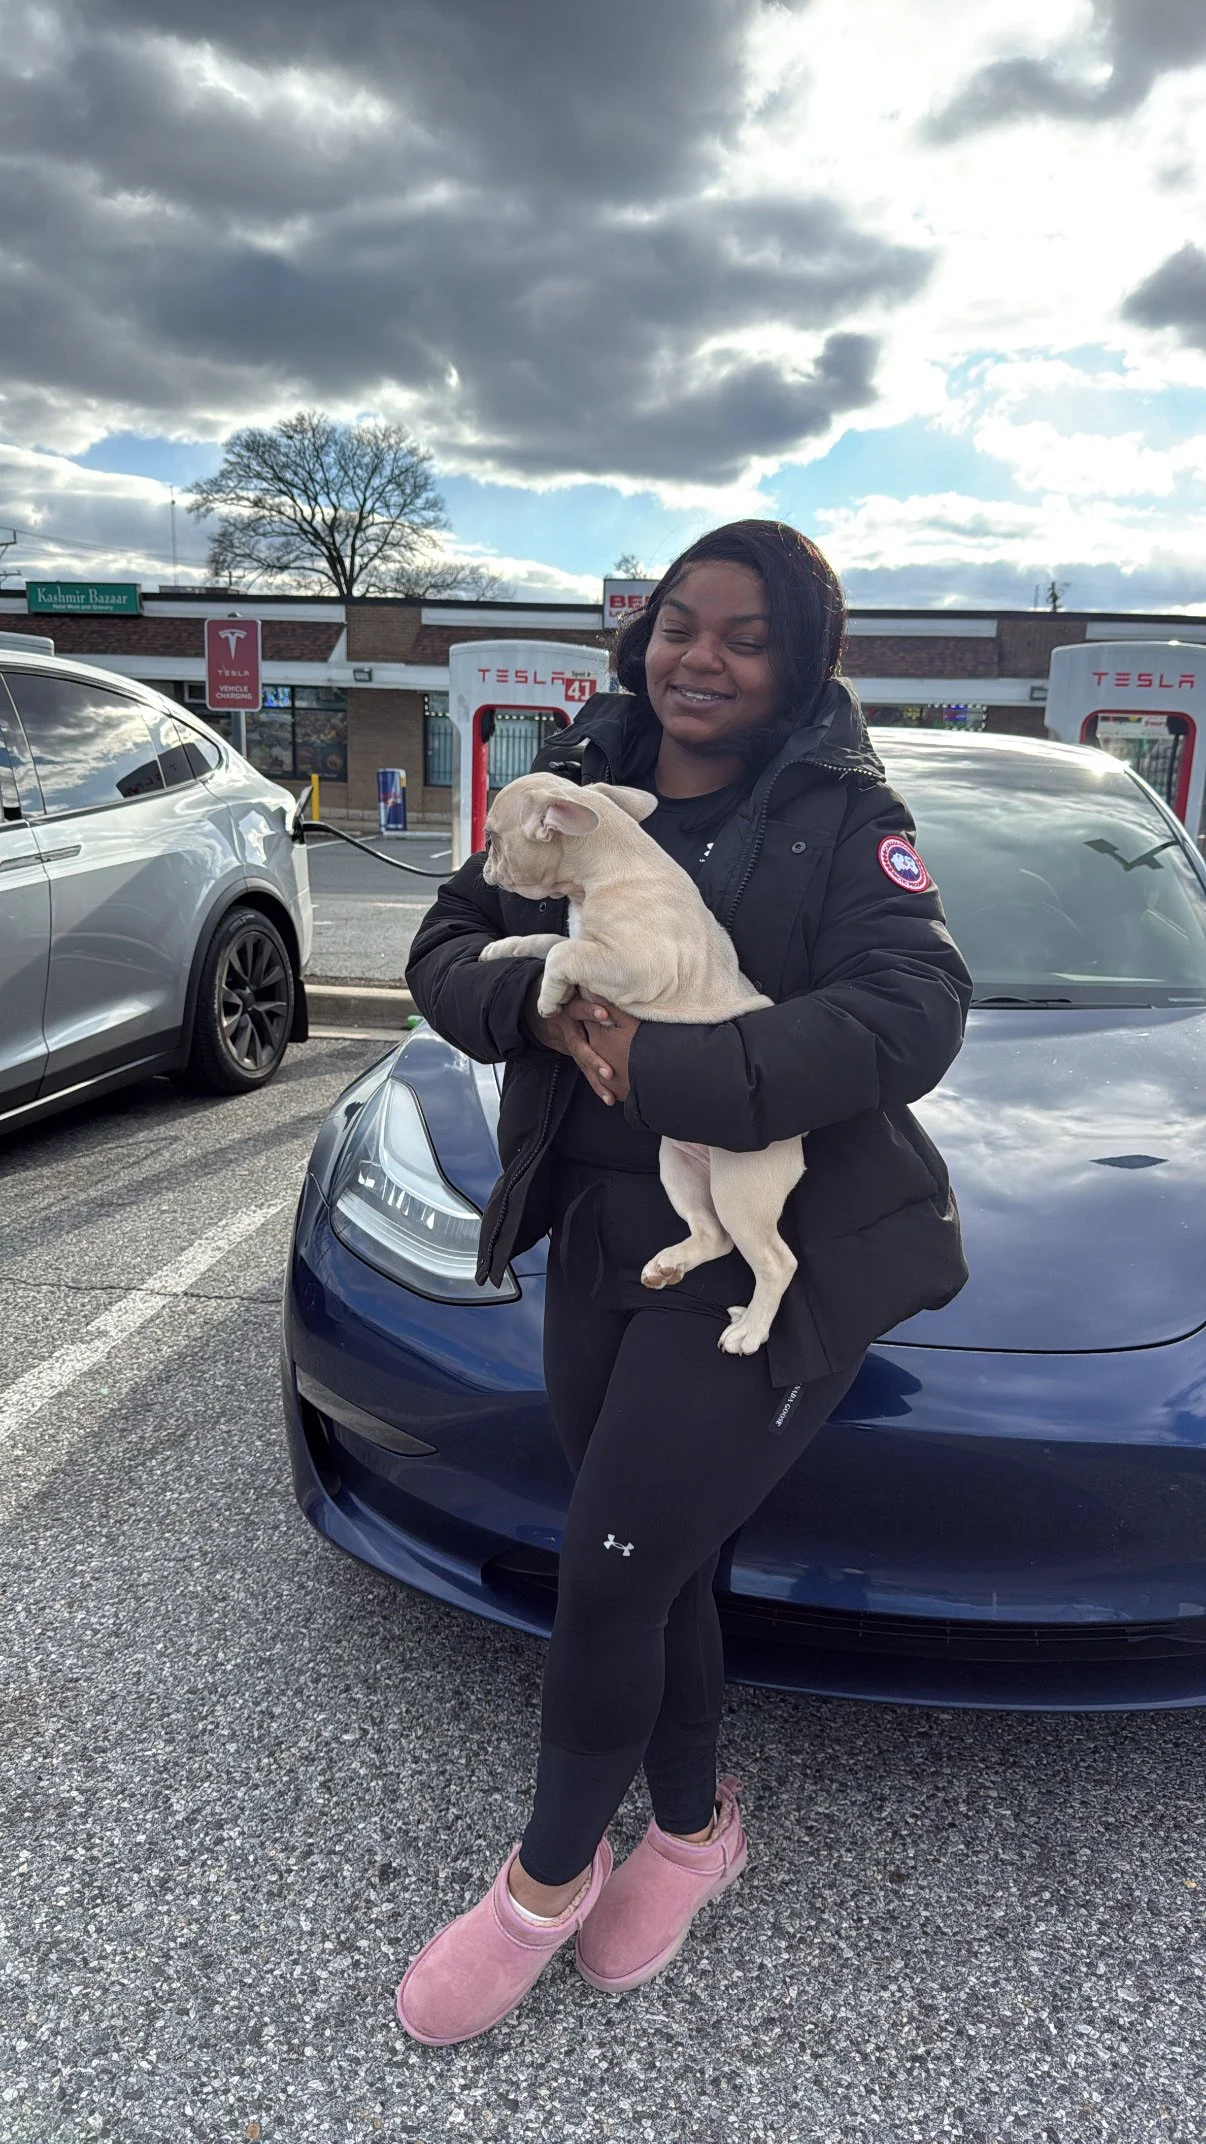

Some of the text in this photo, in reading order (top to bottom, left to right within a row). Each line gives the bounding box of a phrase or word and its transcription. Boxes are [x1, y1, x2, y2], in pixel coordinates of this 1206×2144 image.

[37, 585, 128, 605] Kashmir Bazaar
[477, 668, 565, 685] TESLA
[1091, 672, 1196, 689] TESLA
[215, 692, 253, 700] CHARGING
[566, 681, 591, 700] 41
[775, 1383, 802, 1428] NADA GOOSE
